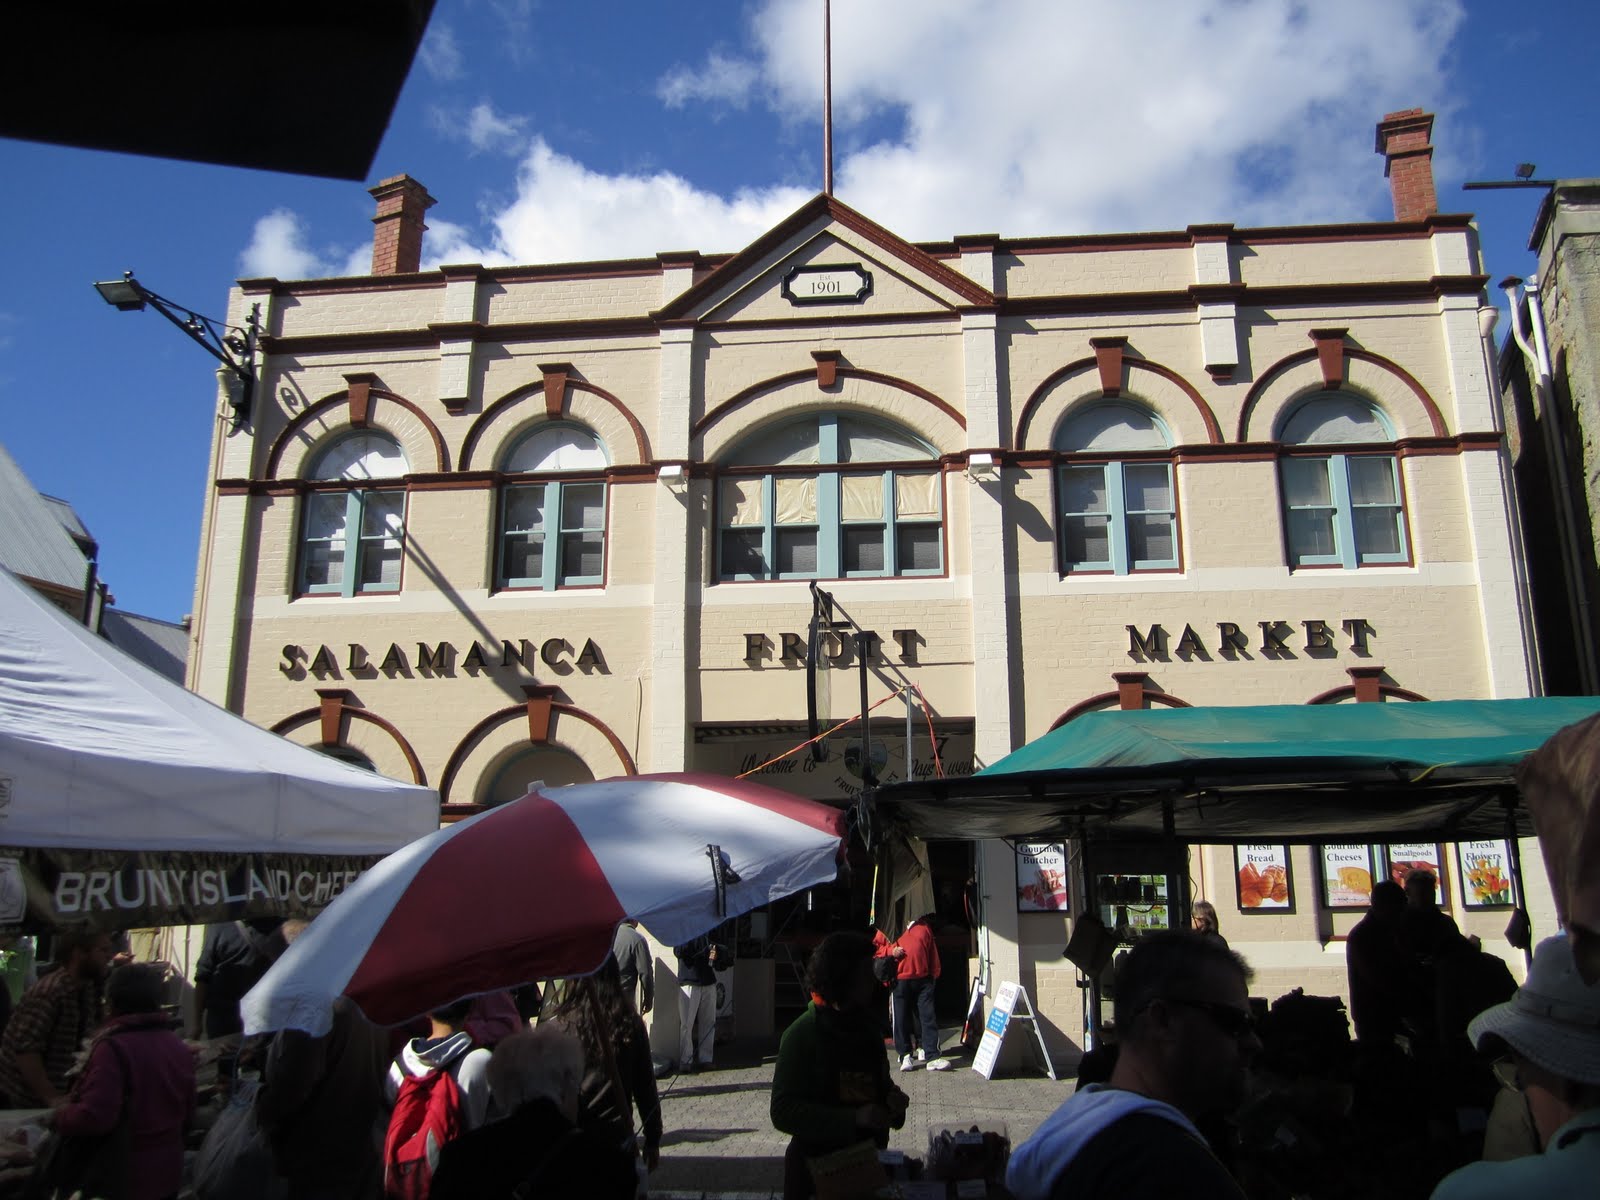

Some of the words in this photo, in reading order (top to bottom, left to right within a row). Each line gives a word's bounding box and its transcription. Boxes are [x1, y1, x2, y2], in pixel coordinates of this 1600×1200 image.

[811, 281, 841, 294] 1901
[1125, 618, 1367, 652] MARKET
[279, 637, 603, 673] SALAMANCA
[930, 737, 949, 760] 7
[803, 752, 817, 773] to
[1469, 841, 1495, 849] Fresh
[1247, 854, 1274, 863] Bread
[1326, 853, 1363, 862] Cheeses
[1393, 850, 1433, 858] Smallgoods
[1466, 851, 1502, 861] Flowers
[1023, 856, 1059, 865] Butcher
[55, 869, 187, 912] BRUNY
[192, 869, 290, 905] ISLAND
